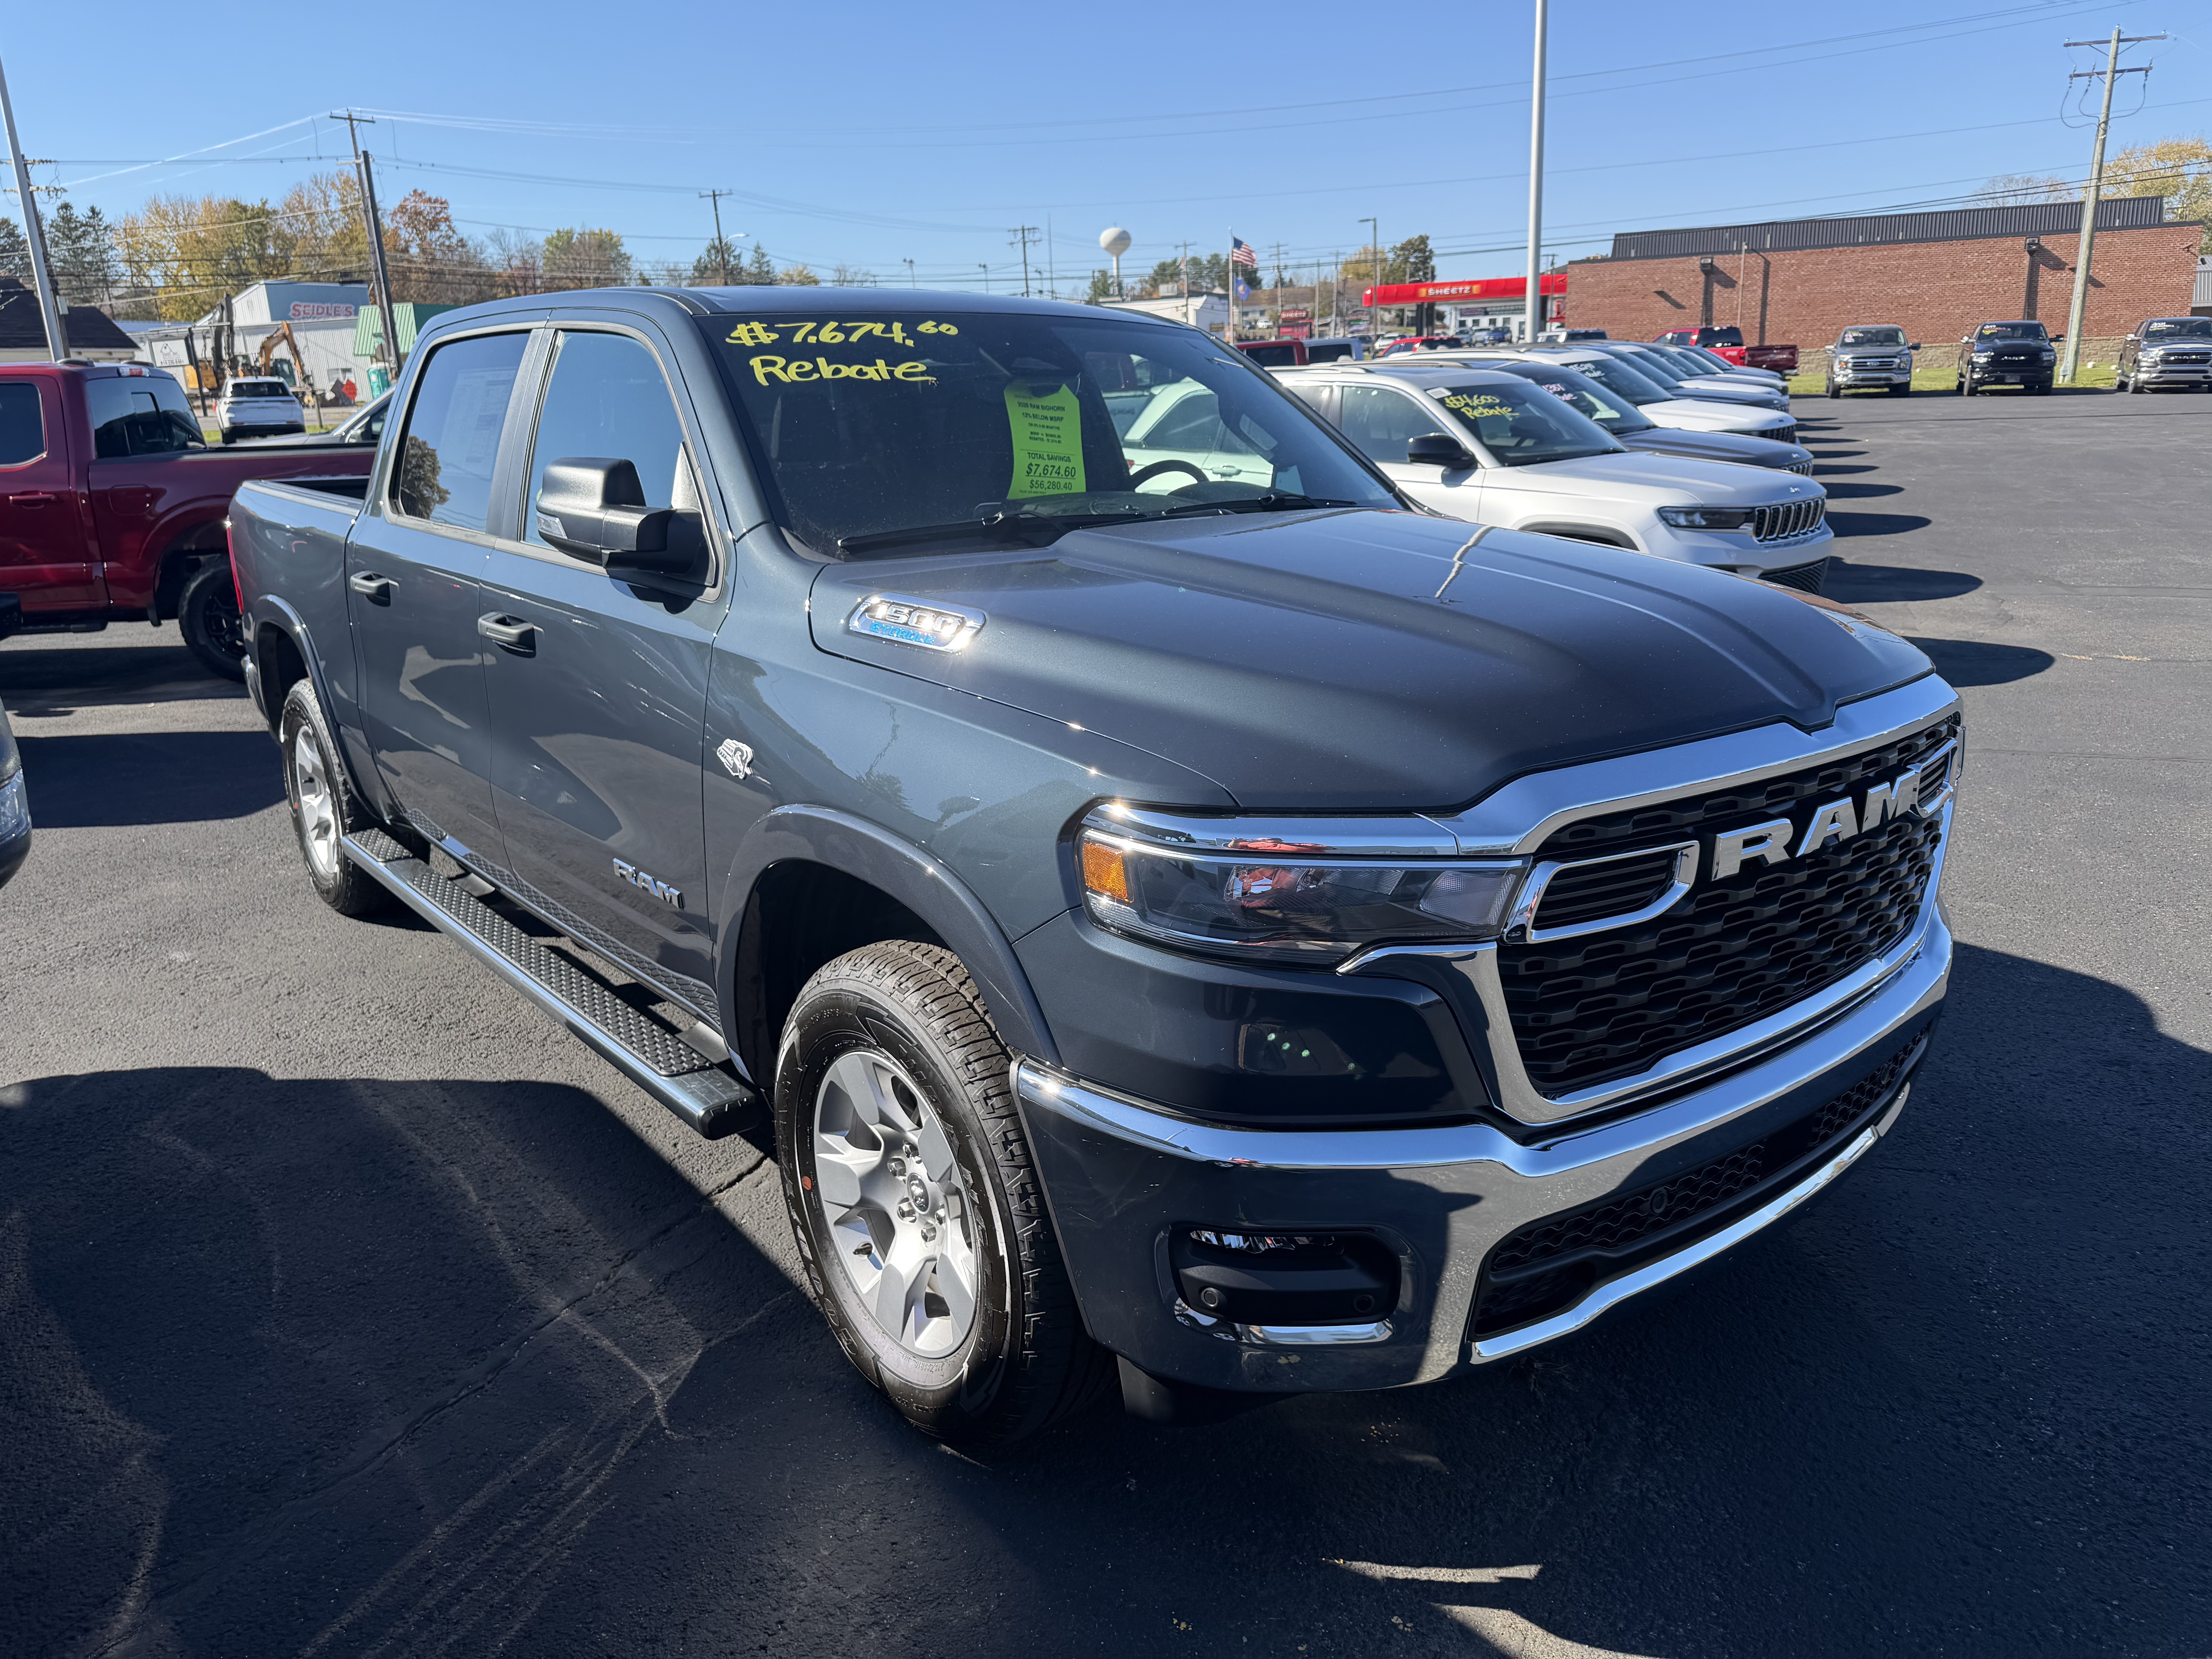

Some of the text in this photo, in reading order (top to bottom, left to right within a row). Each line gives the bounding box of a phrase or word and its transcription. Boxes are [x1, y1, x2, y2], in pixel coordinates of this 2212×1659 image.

[1428, 285, 1471, 295] SHEETZ
[290, 302, 353, 317] SEIDLE'S
[749, 355, 937, 386] Rebate
[1460, 406, 1520, 419] Rebate
[1027, 452, 1072, 463] TOTAL SAVINGS
[1026, 462, 1076, 477] $7,674.60
[1029, 479, 1072, 491] $56,280.40
[1711, 768, 1918, 882] RAM
[613, 857, 685, 910] RAM
